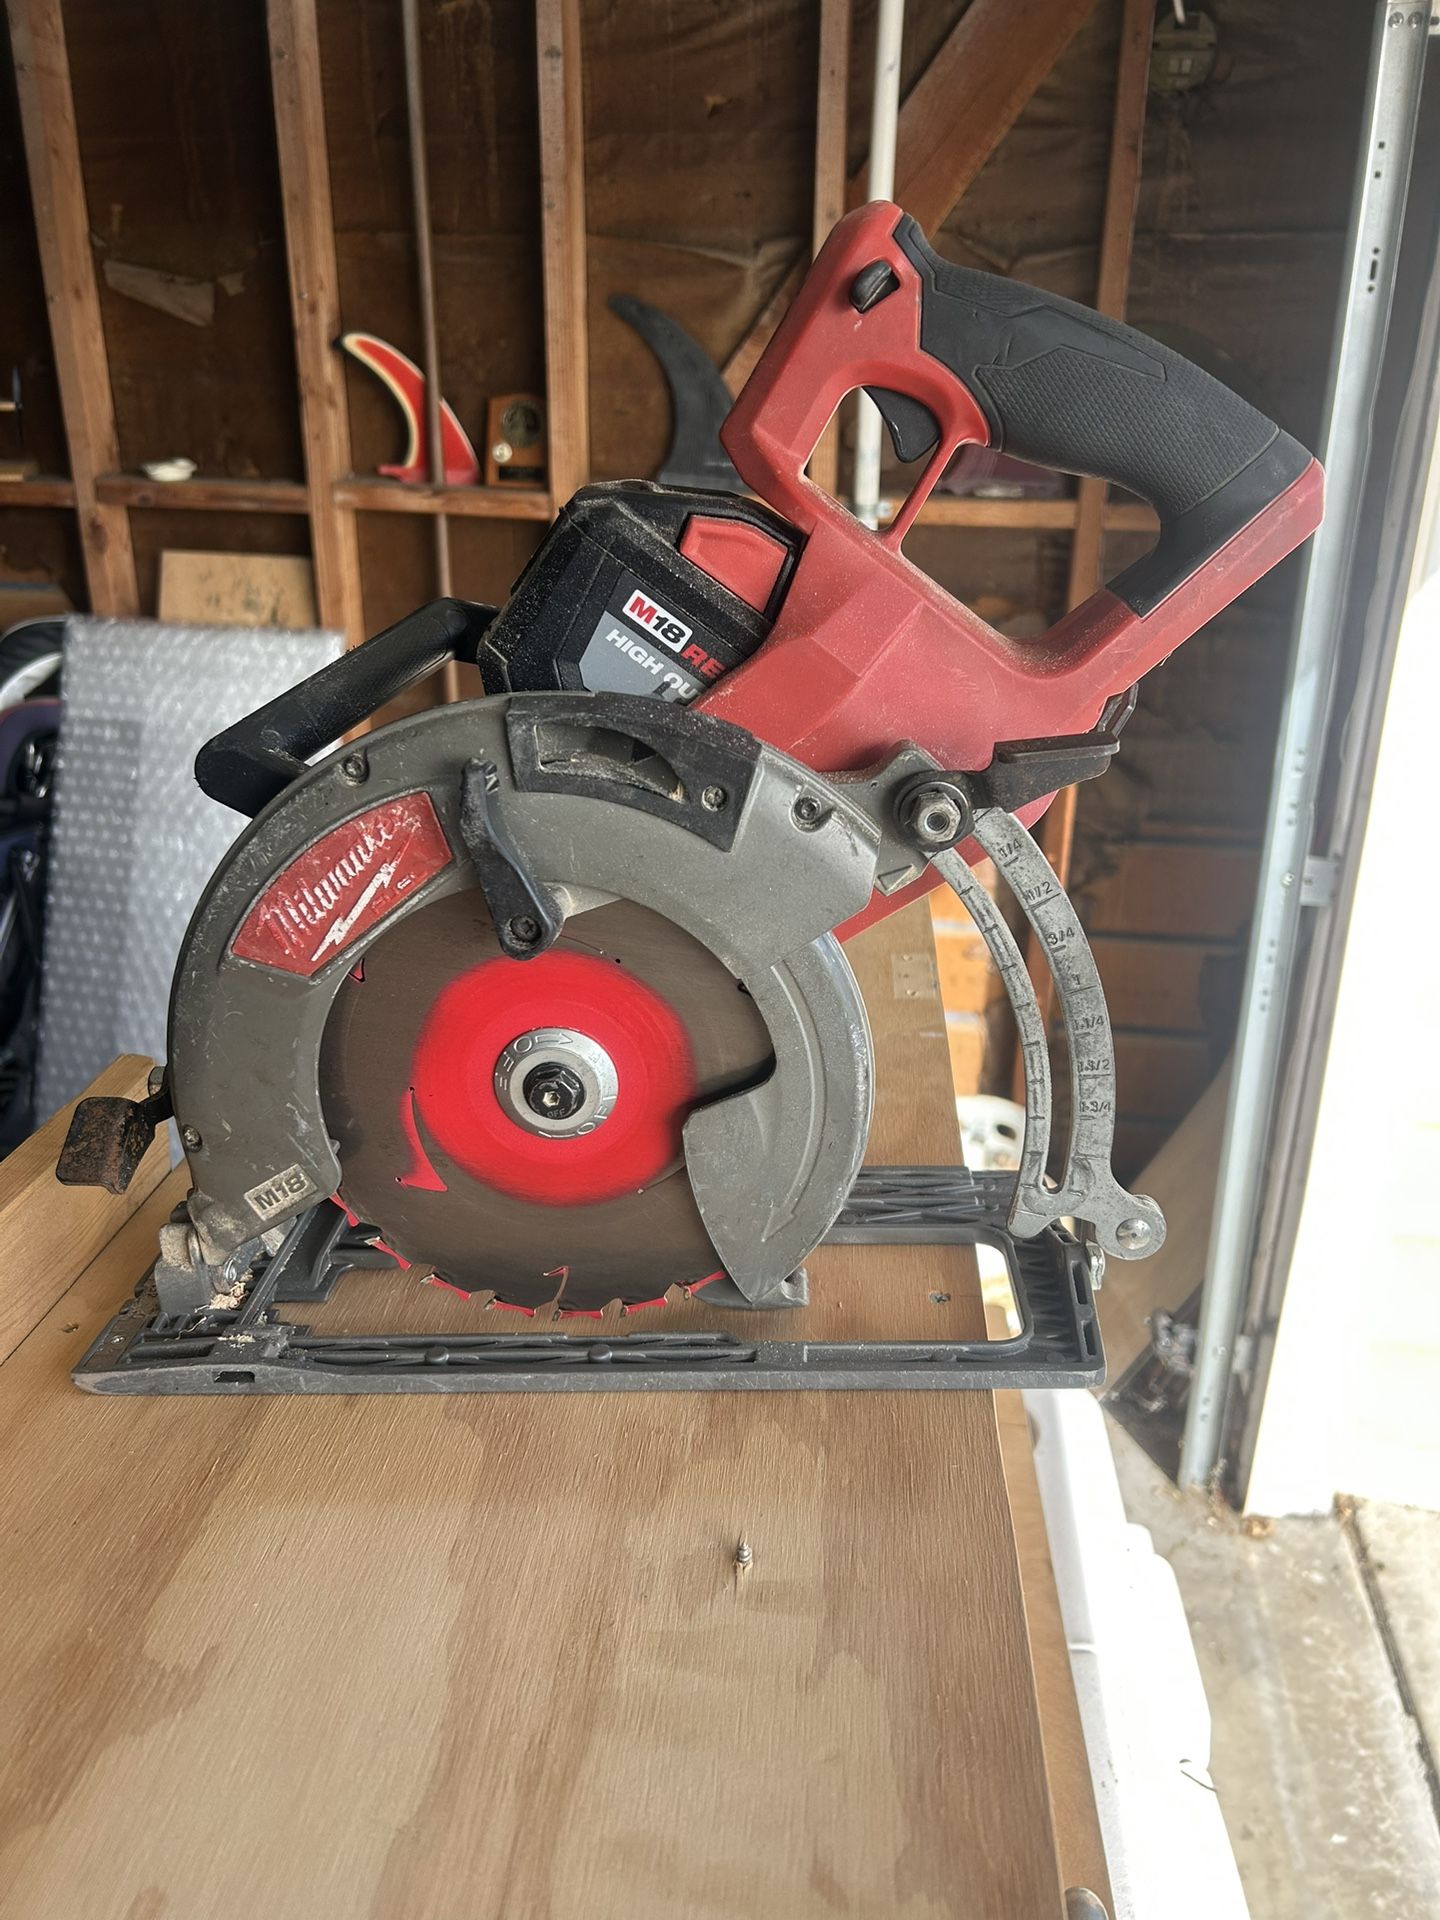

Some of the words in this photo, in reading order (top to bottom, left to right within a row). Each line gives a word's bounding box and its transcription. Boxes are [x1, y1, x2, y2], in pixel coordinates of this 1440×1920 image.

[628, 596, 686, 644] M18
[605, 628, 664, 675] HIGH
[1047, 926, 1075, 945] 3/4
[254, 1172, 307, 1210] M18
